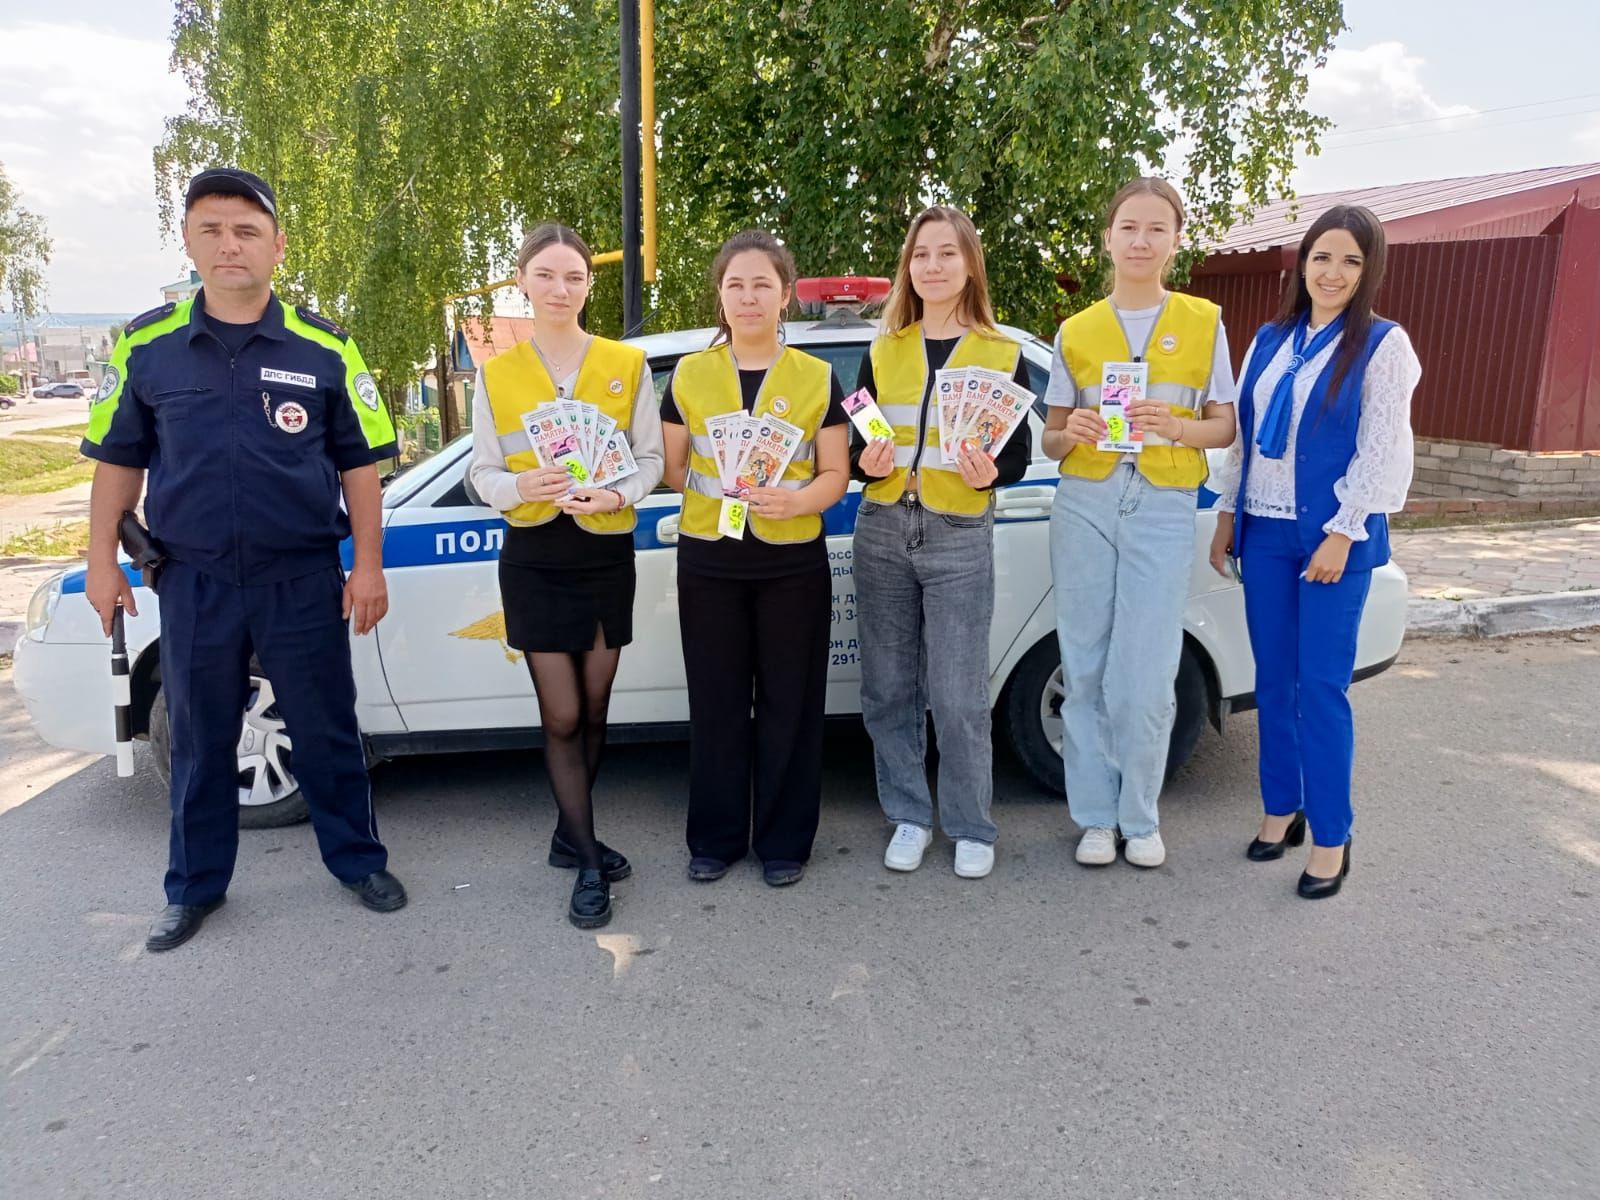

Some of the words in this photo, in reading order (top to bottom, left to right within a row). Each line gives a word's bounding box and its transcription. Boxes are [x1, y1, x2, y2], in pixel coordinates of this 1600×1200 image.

[263, 369, 283, 380] ДПС
[284, 373, 315, 386] ГИБДД
[435, 528, 504, 555] ПОЛ
